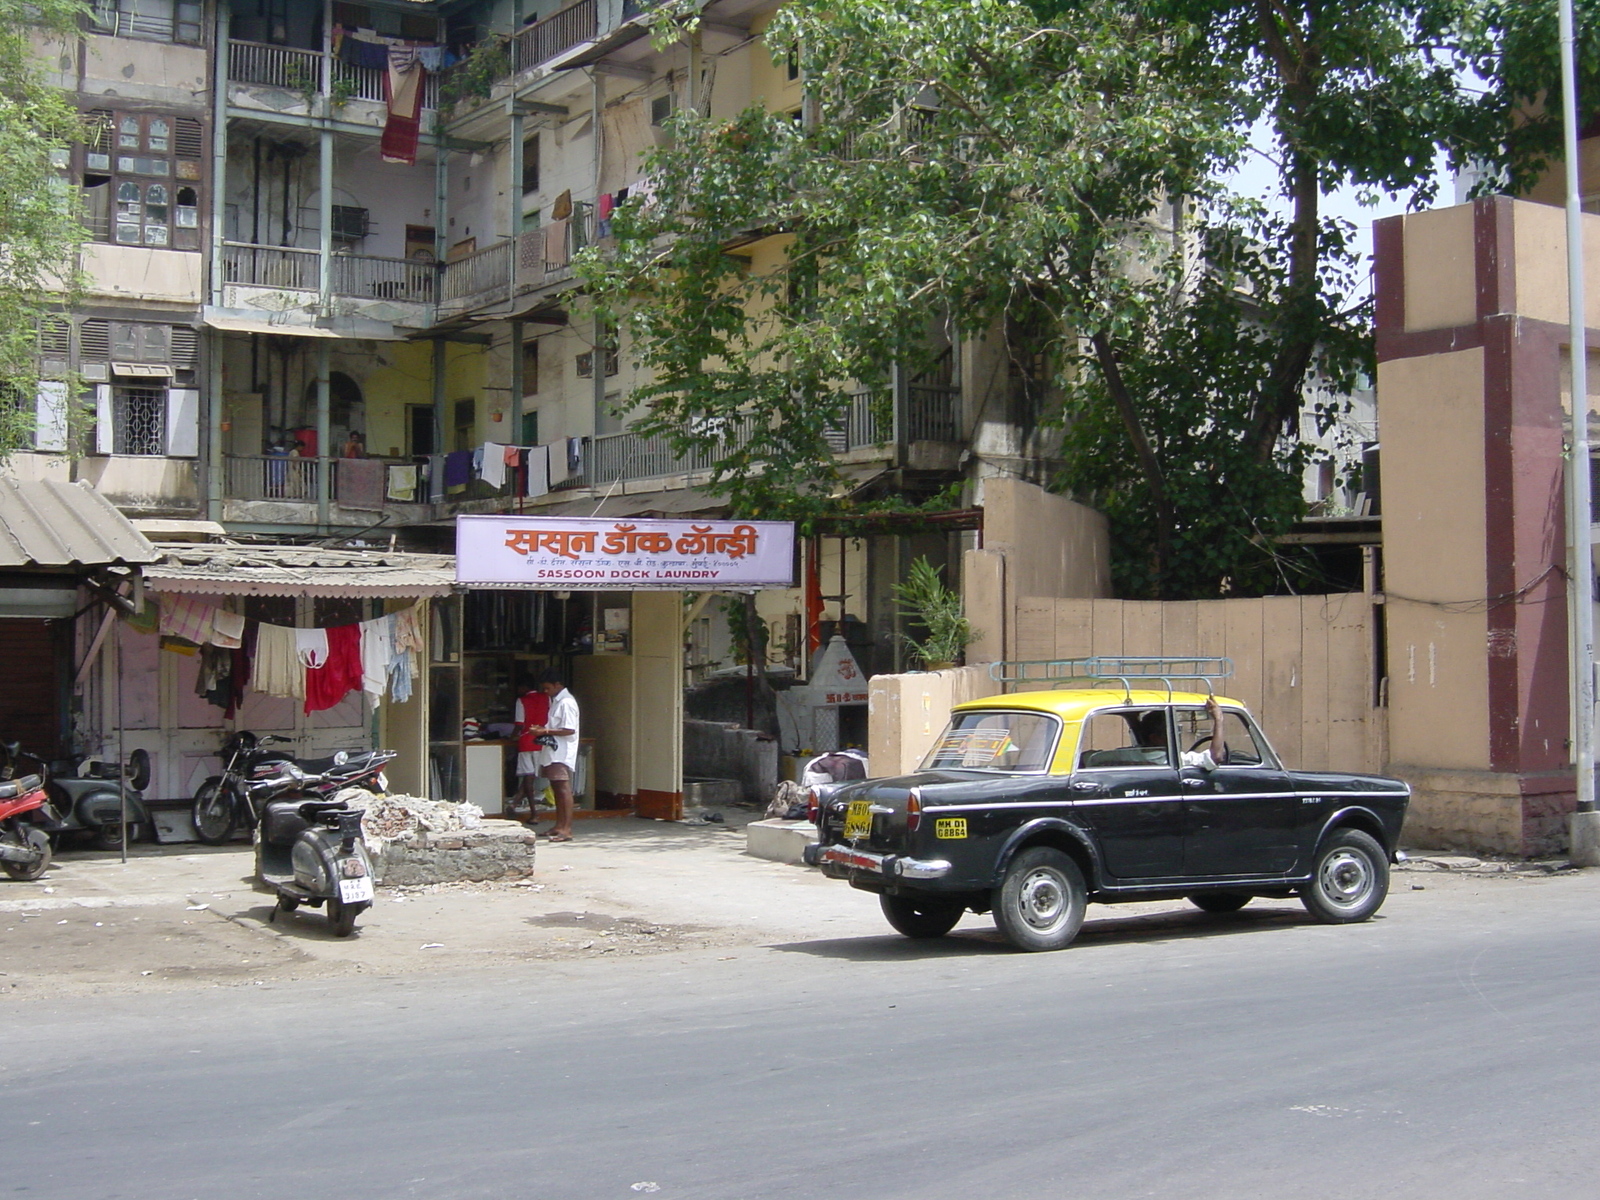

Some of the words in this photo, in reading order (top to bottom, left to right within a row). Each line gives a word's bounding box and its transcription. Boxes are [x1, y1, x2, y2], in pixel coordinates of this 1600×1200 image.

[504, 529, 599, 560] ससून
[601, 522, 673, 555] डॉक
[675, 524, 759, 560] लॉन्ड्री
[537, 569, 606, 579] SASSOON
[610, 570, 651, 579] DOCK
[656, 570, 720, 579] LAUNDRY
[938, 820, 951, 828] MH
[954, 820, 965, 828] 01
[938, 828, 966, 837] G8864
